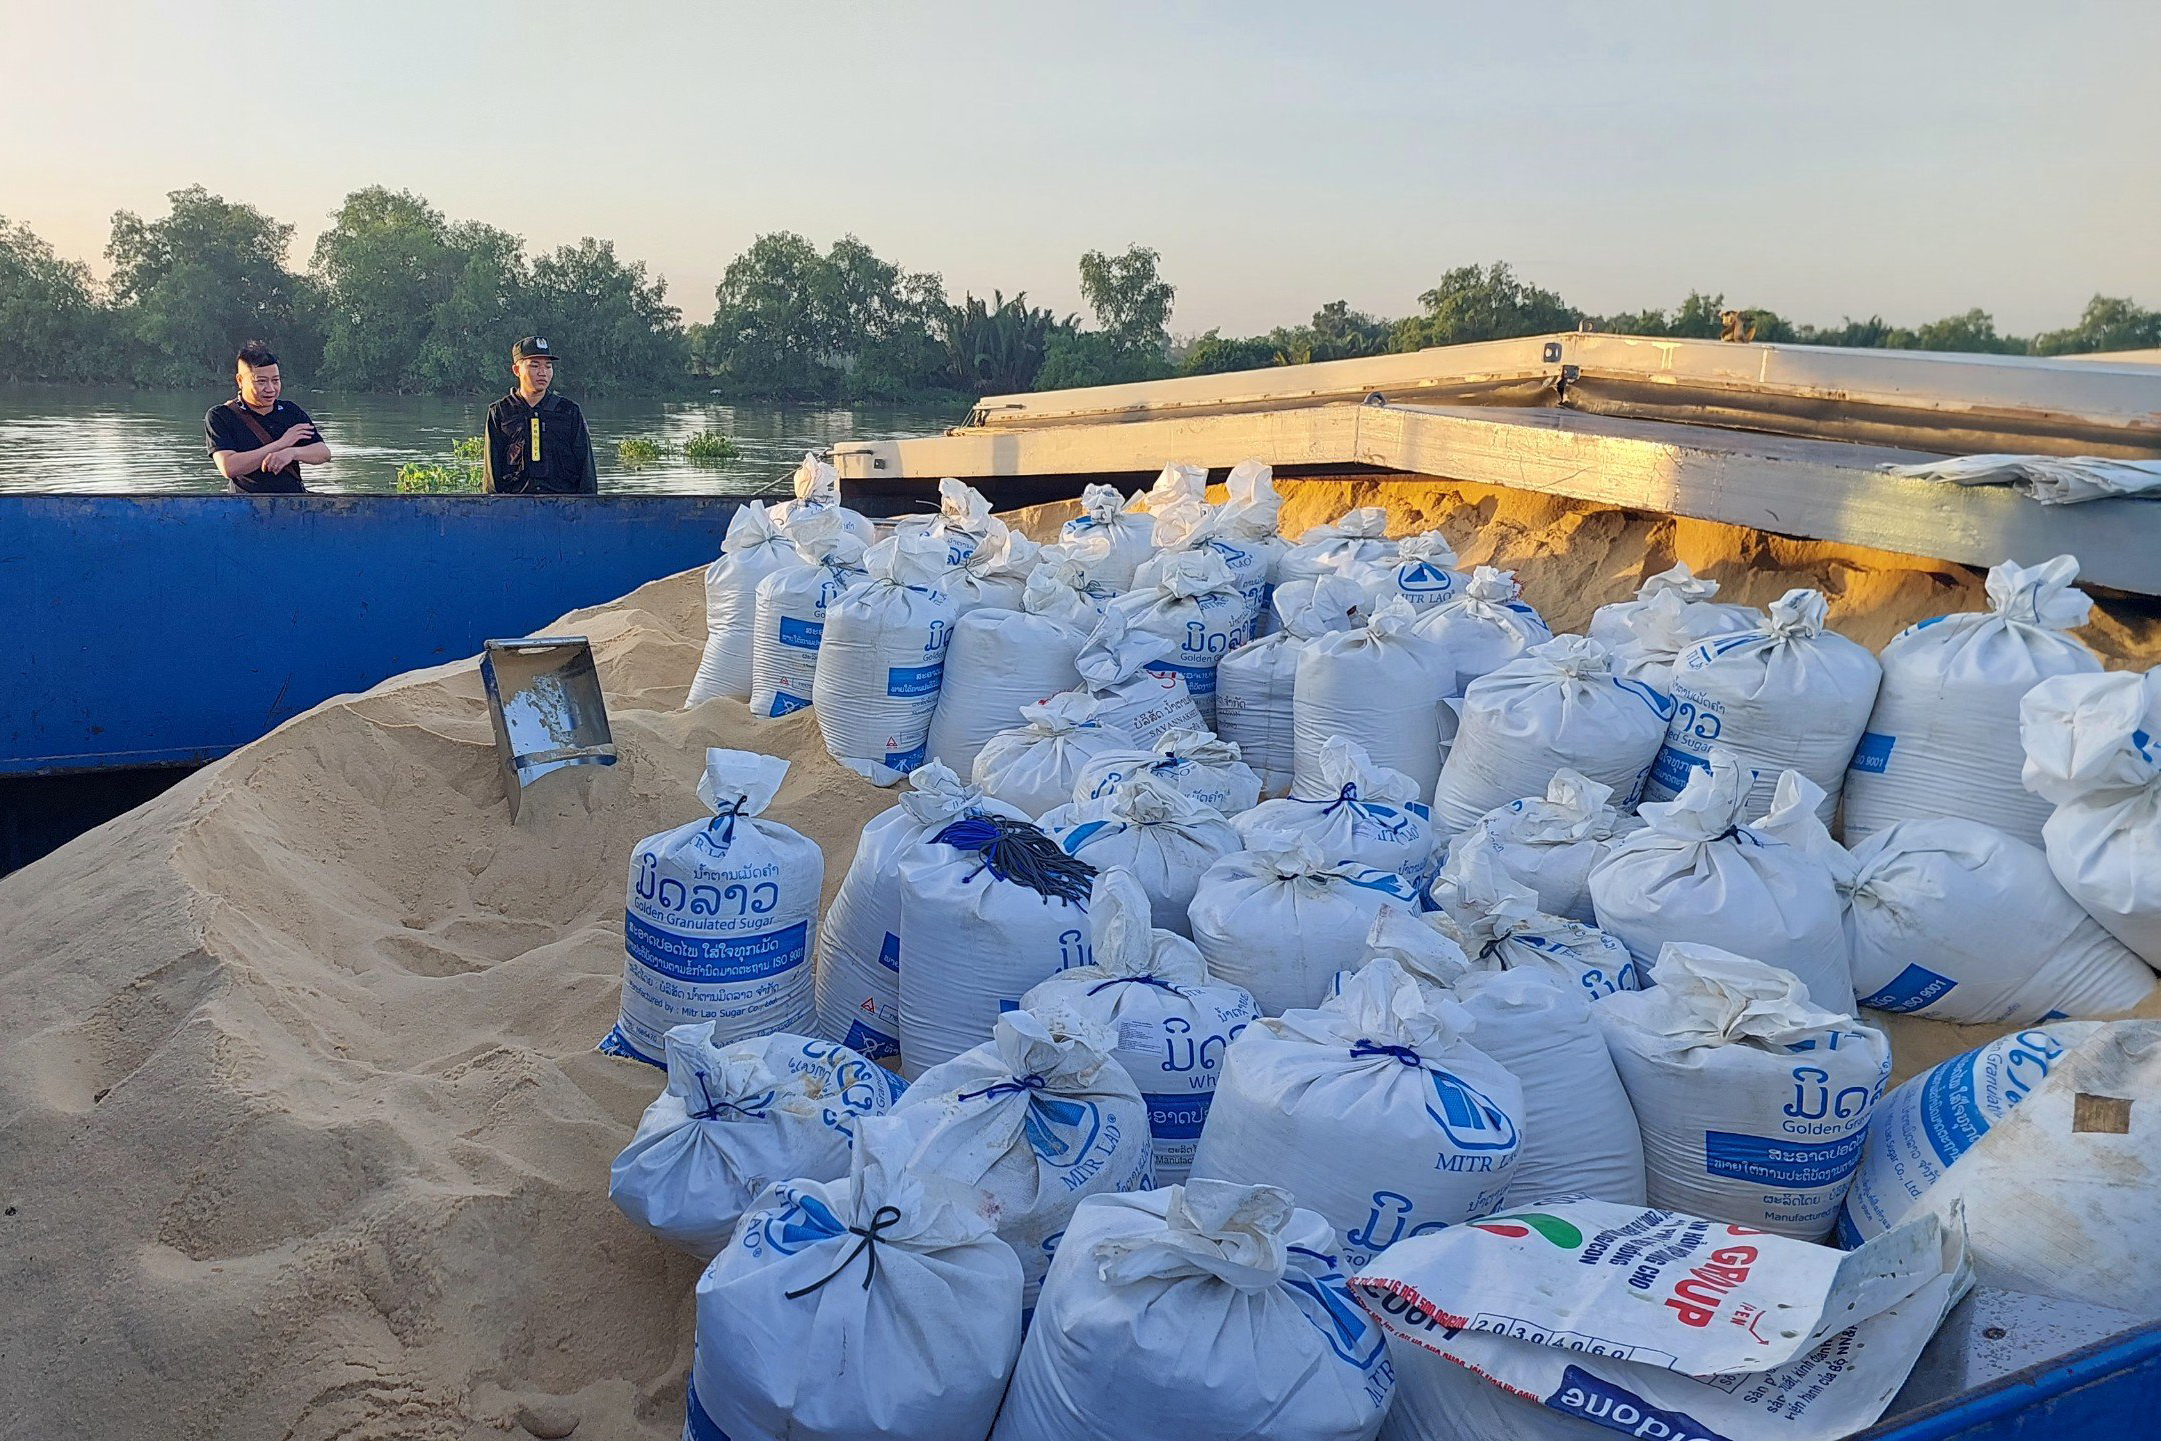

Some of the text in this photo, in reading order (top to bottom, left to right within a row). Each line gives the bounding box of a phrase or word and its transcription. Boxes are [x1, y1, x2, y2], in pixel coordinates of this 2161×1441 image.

[1180, 652, 1212, 663] Golden
[636, 852, 779, 915] ມິດລາວ
[634, 896, 775, 931] Golden Granulated Sugar
[772, 954, 787, 968] ISO
[1919, 979, 1946, 998] 9001
[665, 1001, 673, 1013] by
[682, 1007, 698, 1017] Mitr
[701, 1009, 717, 1018] Lao
[719, 1008, 745, 1018] Sugar
[1782, 1120, 1841, 1135] Golden
[1434, 1152, 1493, 1172] MITR
[1060, 1158, 1104, 1192] MITR
[1903, 1181, 1922, 1200] Ltd.
[1764, 1210, 1831, 1222] Manufactured
[1628, 1265, 1661, 1289] CHO
[1794, 1359, 1815, 1380] kinh
[1743, 1384, 1769, 1404] Sản
